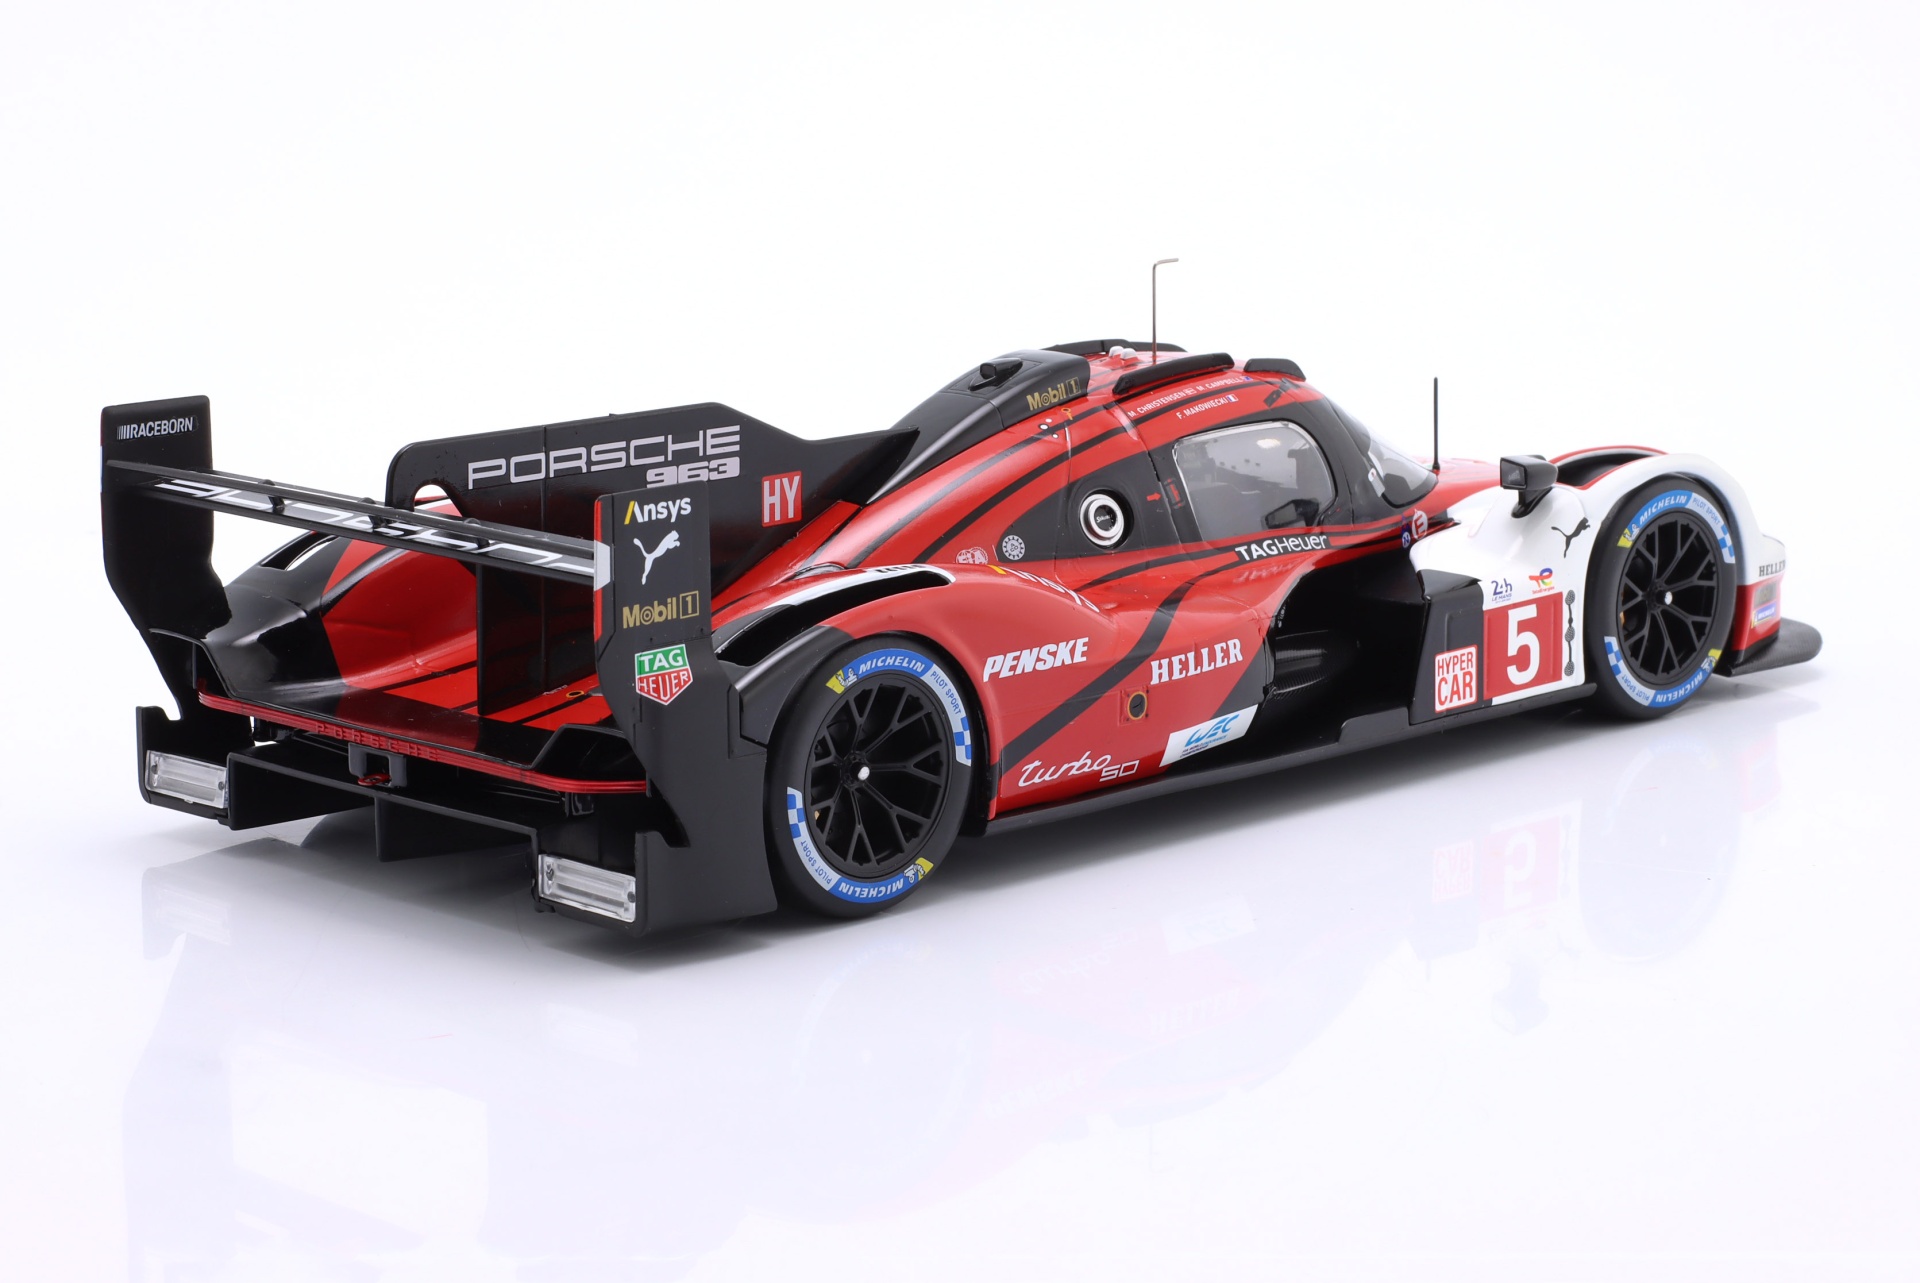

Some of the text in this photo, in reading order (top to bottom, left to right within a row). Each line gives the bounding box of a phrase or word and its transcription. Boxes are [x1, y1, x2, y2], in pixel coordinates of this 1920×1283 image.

[1027, 383, 1066, 411] Mobil
[1137, 391, 1186, 413] CHRISTENSEN
[1184, 397, 1228, 416] MAKOWIECKI
[130, 416, 194, 439] RACEBORN
[468, 425, 740, 490] PORSCHE
[646, 456, 740, 489] 963
[624, 497, 692, 525] Ansys
[764, 476, 800, 524] HY
[1639, 495, 1688, 525] MICHELIN
[1705, 508, 1721, 526] SPORT
[622, 597, 677, 629] Mobil
[983, 637, 1089, 682] PENSKE
[1507, 604, 1540, 685] 5
[639, 649, 684, 672] TAG
[858, 655, 926, 675] MICHELIN
[1150, 638, 1243, 685] HELLER
[1437, 651, 1473, 678] HYPER
[638, 671, 690, 701] HEUER
[930, 670, 962, 715] PILOT SPORT
[1437, 670, 1473, 706] CAR
[1655, 671, 1703, 703] MICHELIN
[1017, 750, 1139, 787] turbo 50
[800, 840, 833, 885] PILOT SPORT
[838, 878, 905, 899] MICHELIN
